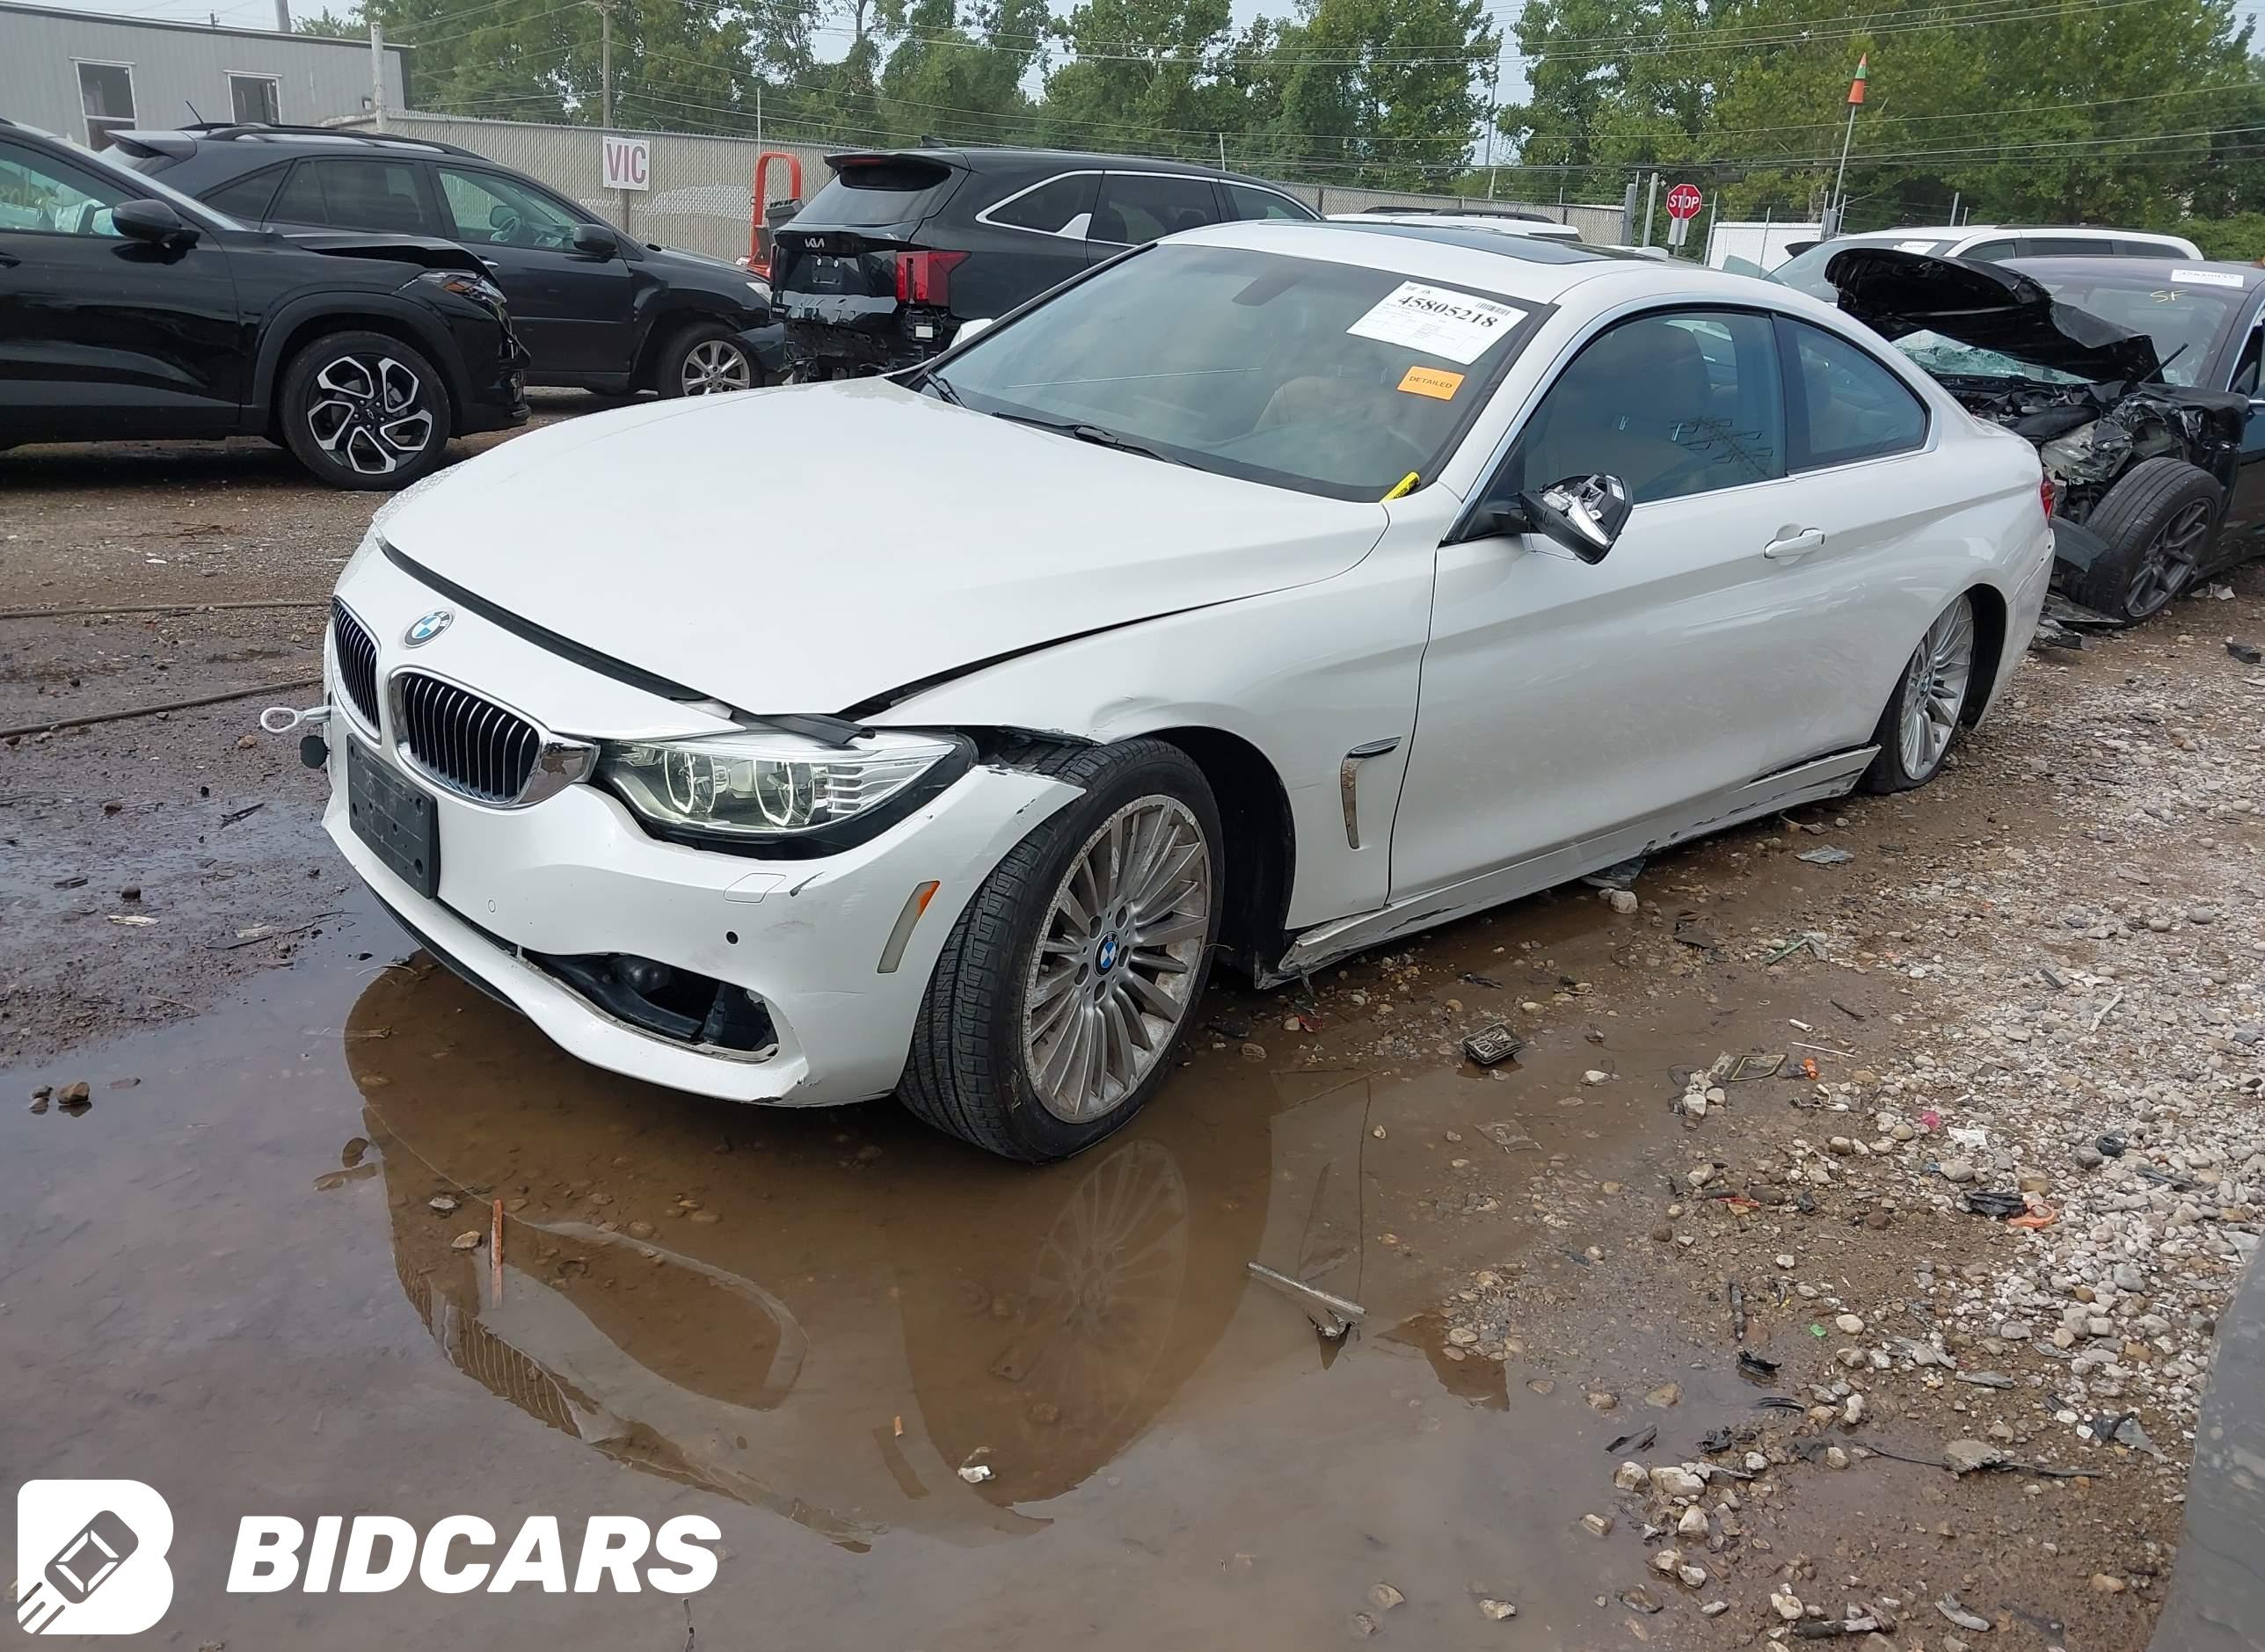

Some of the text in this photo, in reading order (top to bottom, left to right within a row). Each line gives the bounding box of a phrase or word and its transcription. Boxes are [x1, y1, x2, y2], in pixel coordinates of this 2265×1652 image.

[606, 143, 646, 184] VIC
[1669, 194, 1700, 209] STOP
[1398, 295, 1498, 328] 45805218
[1409, 375, 1453, 389] DETAILED
